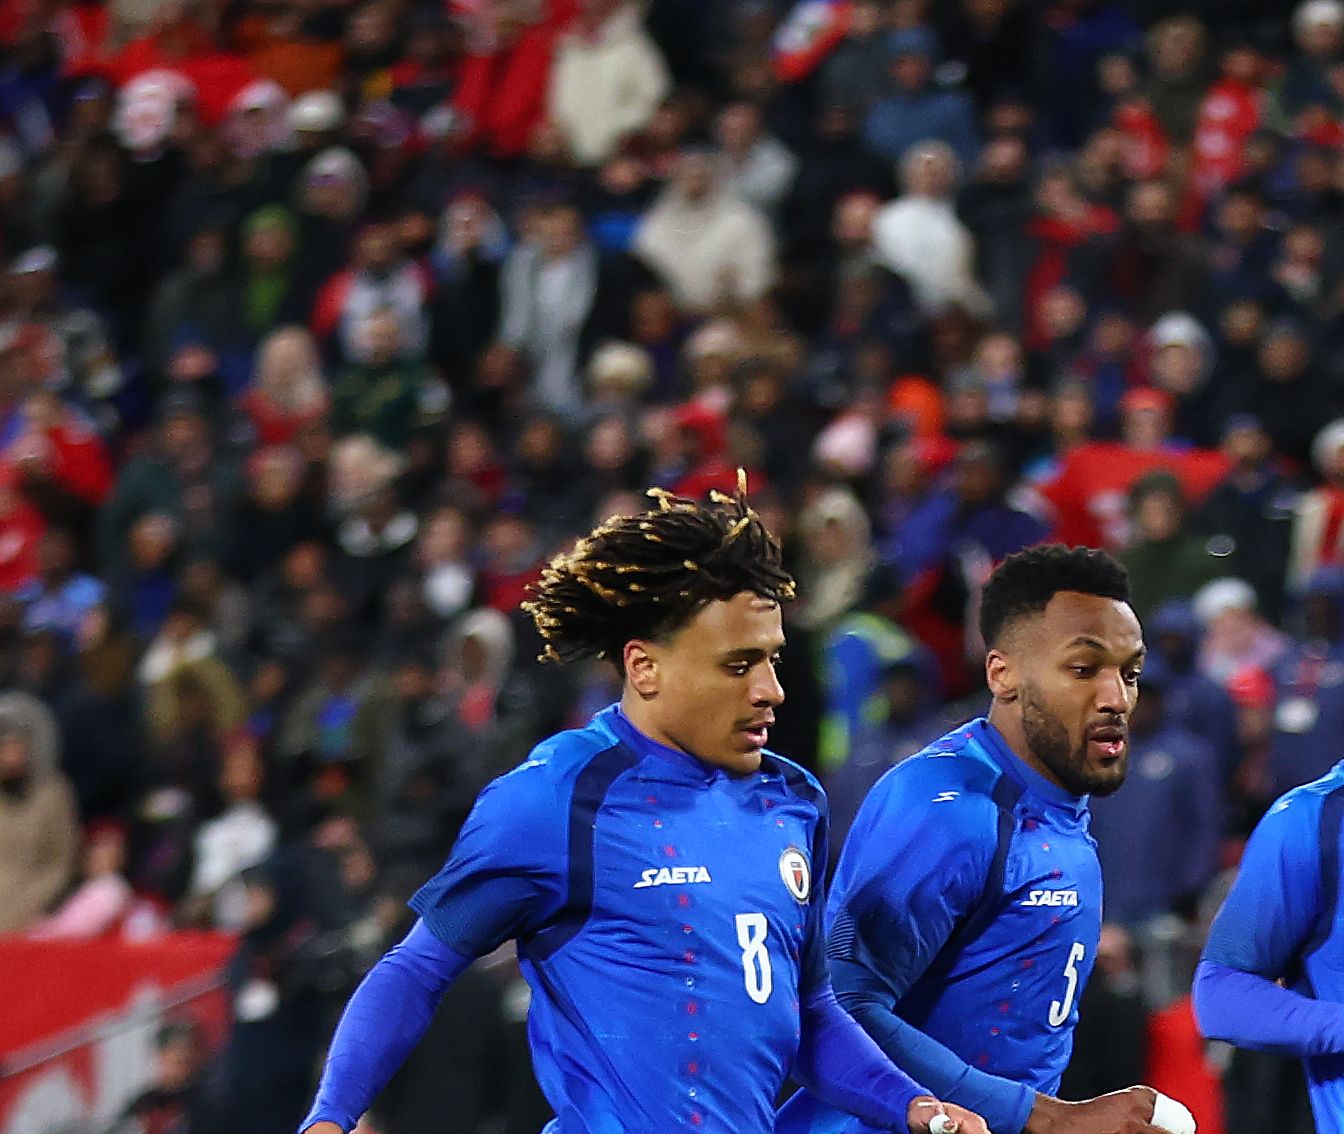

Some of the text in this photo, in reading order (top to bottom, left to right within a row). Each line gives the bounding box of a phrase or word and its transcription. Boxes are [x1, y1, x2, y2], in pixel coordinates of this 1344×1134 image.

[633, 866, 712, 889] SAETA
[1020, 890, 1078, 907] SAETA
[735, 912, 774, 1005] 8
[1048, 942, 1085, 1027] 5
